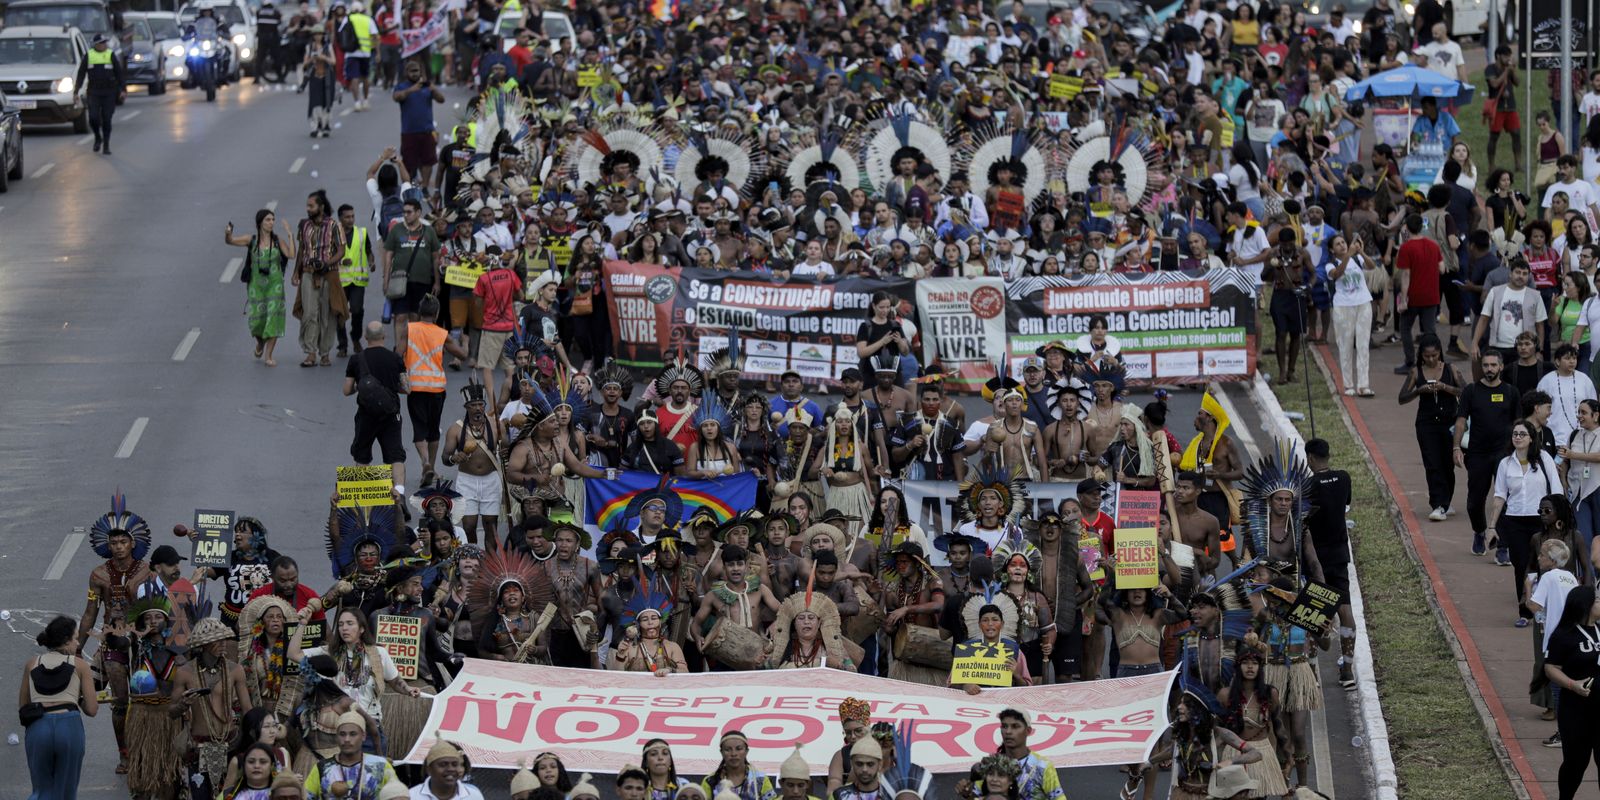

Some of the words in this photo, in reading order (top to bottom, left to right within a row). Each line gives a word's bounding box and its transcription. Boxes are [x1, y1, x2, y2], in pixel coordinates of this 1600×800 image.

[689, 279, 708, 300] Se
[711, 284, 722, 301] a
[724, 283, 832, 311] CONSTITUIÇÃO
[1048, 288, 1130, 310] Juventude
[1132, 286, 1204, 308] indígena
[615, 298, 655, 319] TERRA
[685, 307, 696, 324] o
[700, 307, 752, 328] ESTADO
[756, 313, 787, 332] tem
[789, 316, 820, 337] que
[930, 316, 986, 336] TERRA
[1018, 317, 1044, 335] em
[1106, 311, 1126, 332] da
[1128, 306, 1236, 332] Constituição!
[619, 319, 657, 343] LIVRE
[1170, 334, 1187, 346] luta
[1188, 334, 1216, 346] segue
[1218, 331, 1244, 344] forte!
[936, 336, 987, 359] LIVRE
[198, 514, 230, 524] DIREITOS
[196, 539, 228, 558] AÇÃO
[1116, 547, 1156, 562] FUELS!
[1118, 568, 1156, 576] TERRITORIES!
[1308, 582, 1340, 602] DIREITOS
[380, 616, 418, 624] DESMATAMENTO
[1292, 604, 1327, 626] AÇÃO
[379, 623, 418, 636] ZERO
[378, 636, 417, 645] DESMATAMENTO
[956, 662, 989, 670] AMAZÔNIA
[990, 664, 1010, 672] LIVRE
[568, 693, 930, 716] RESPUESTA
